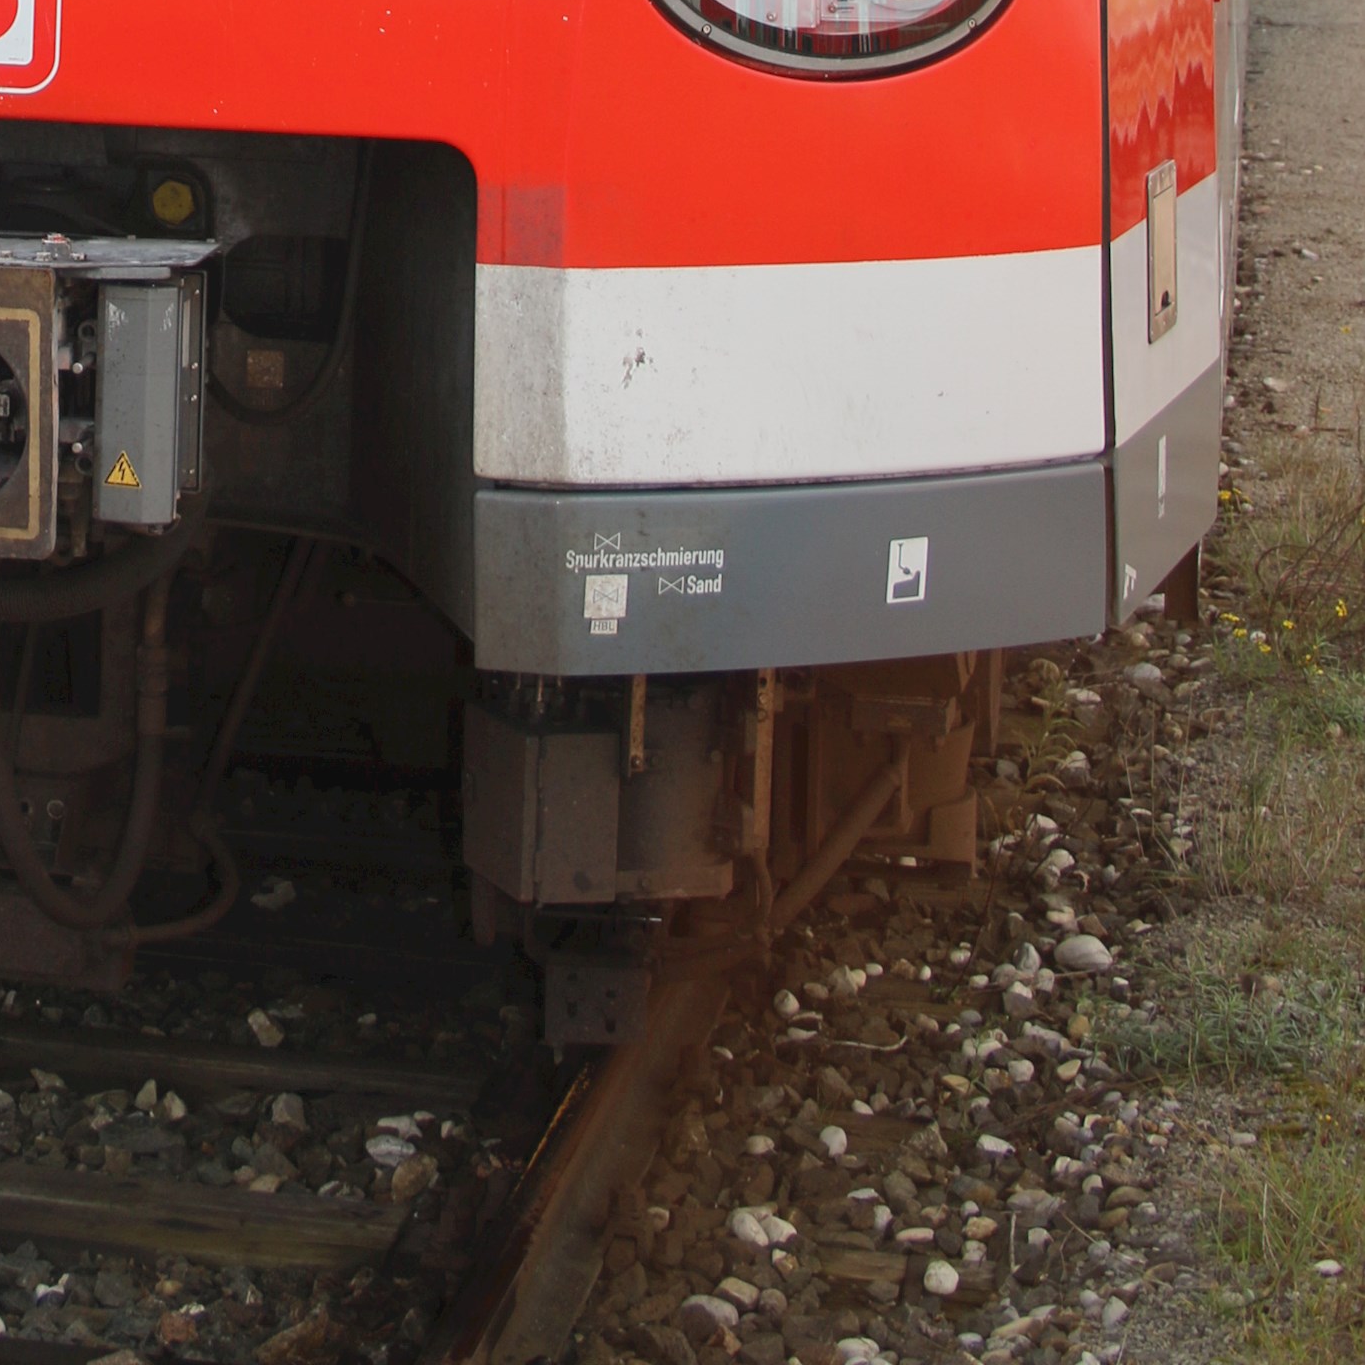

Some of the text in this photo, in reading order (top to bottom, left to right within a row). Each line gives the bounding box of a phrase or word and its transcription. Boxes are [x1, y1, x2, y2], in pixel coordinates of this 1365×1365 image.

[565, 546, 724, 573] Spurkranzschmierung
[686, 572, 723, 594] Sand
[592, 620, 616, 632] HBL
